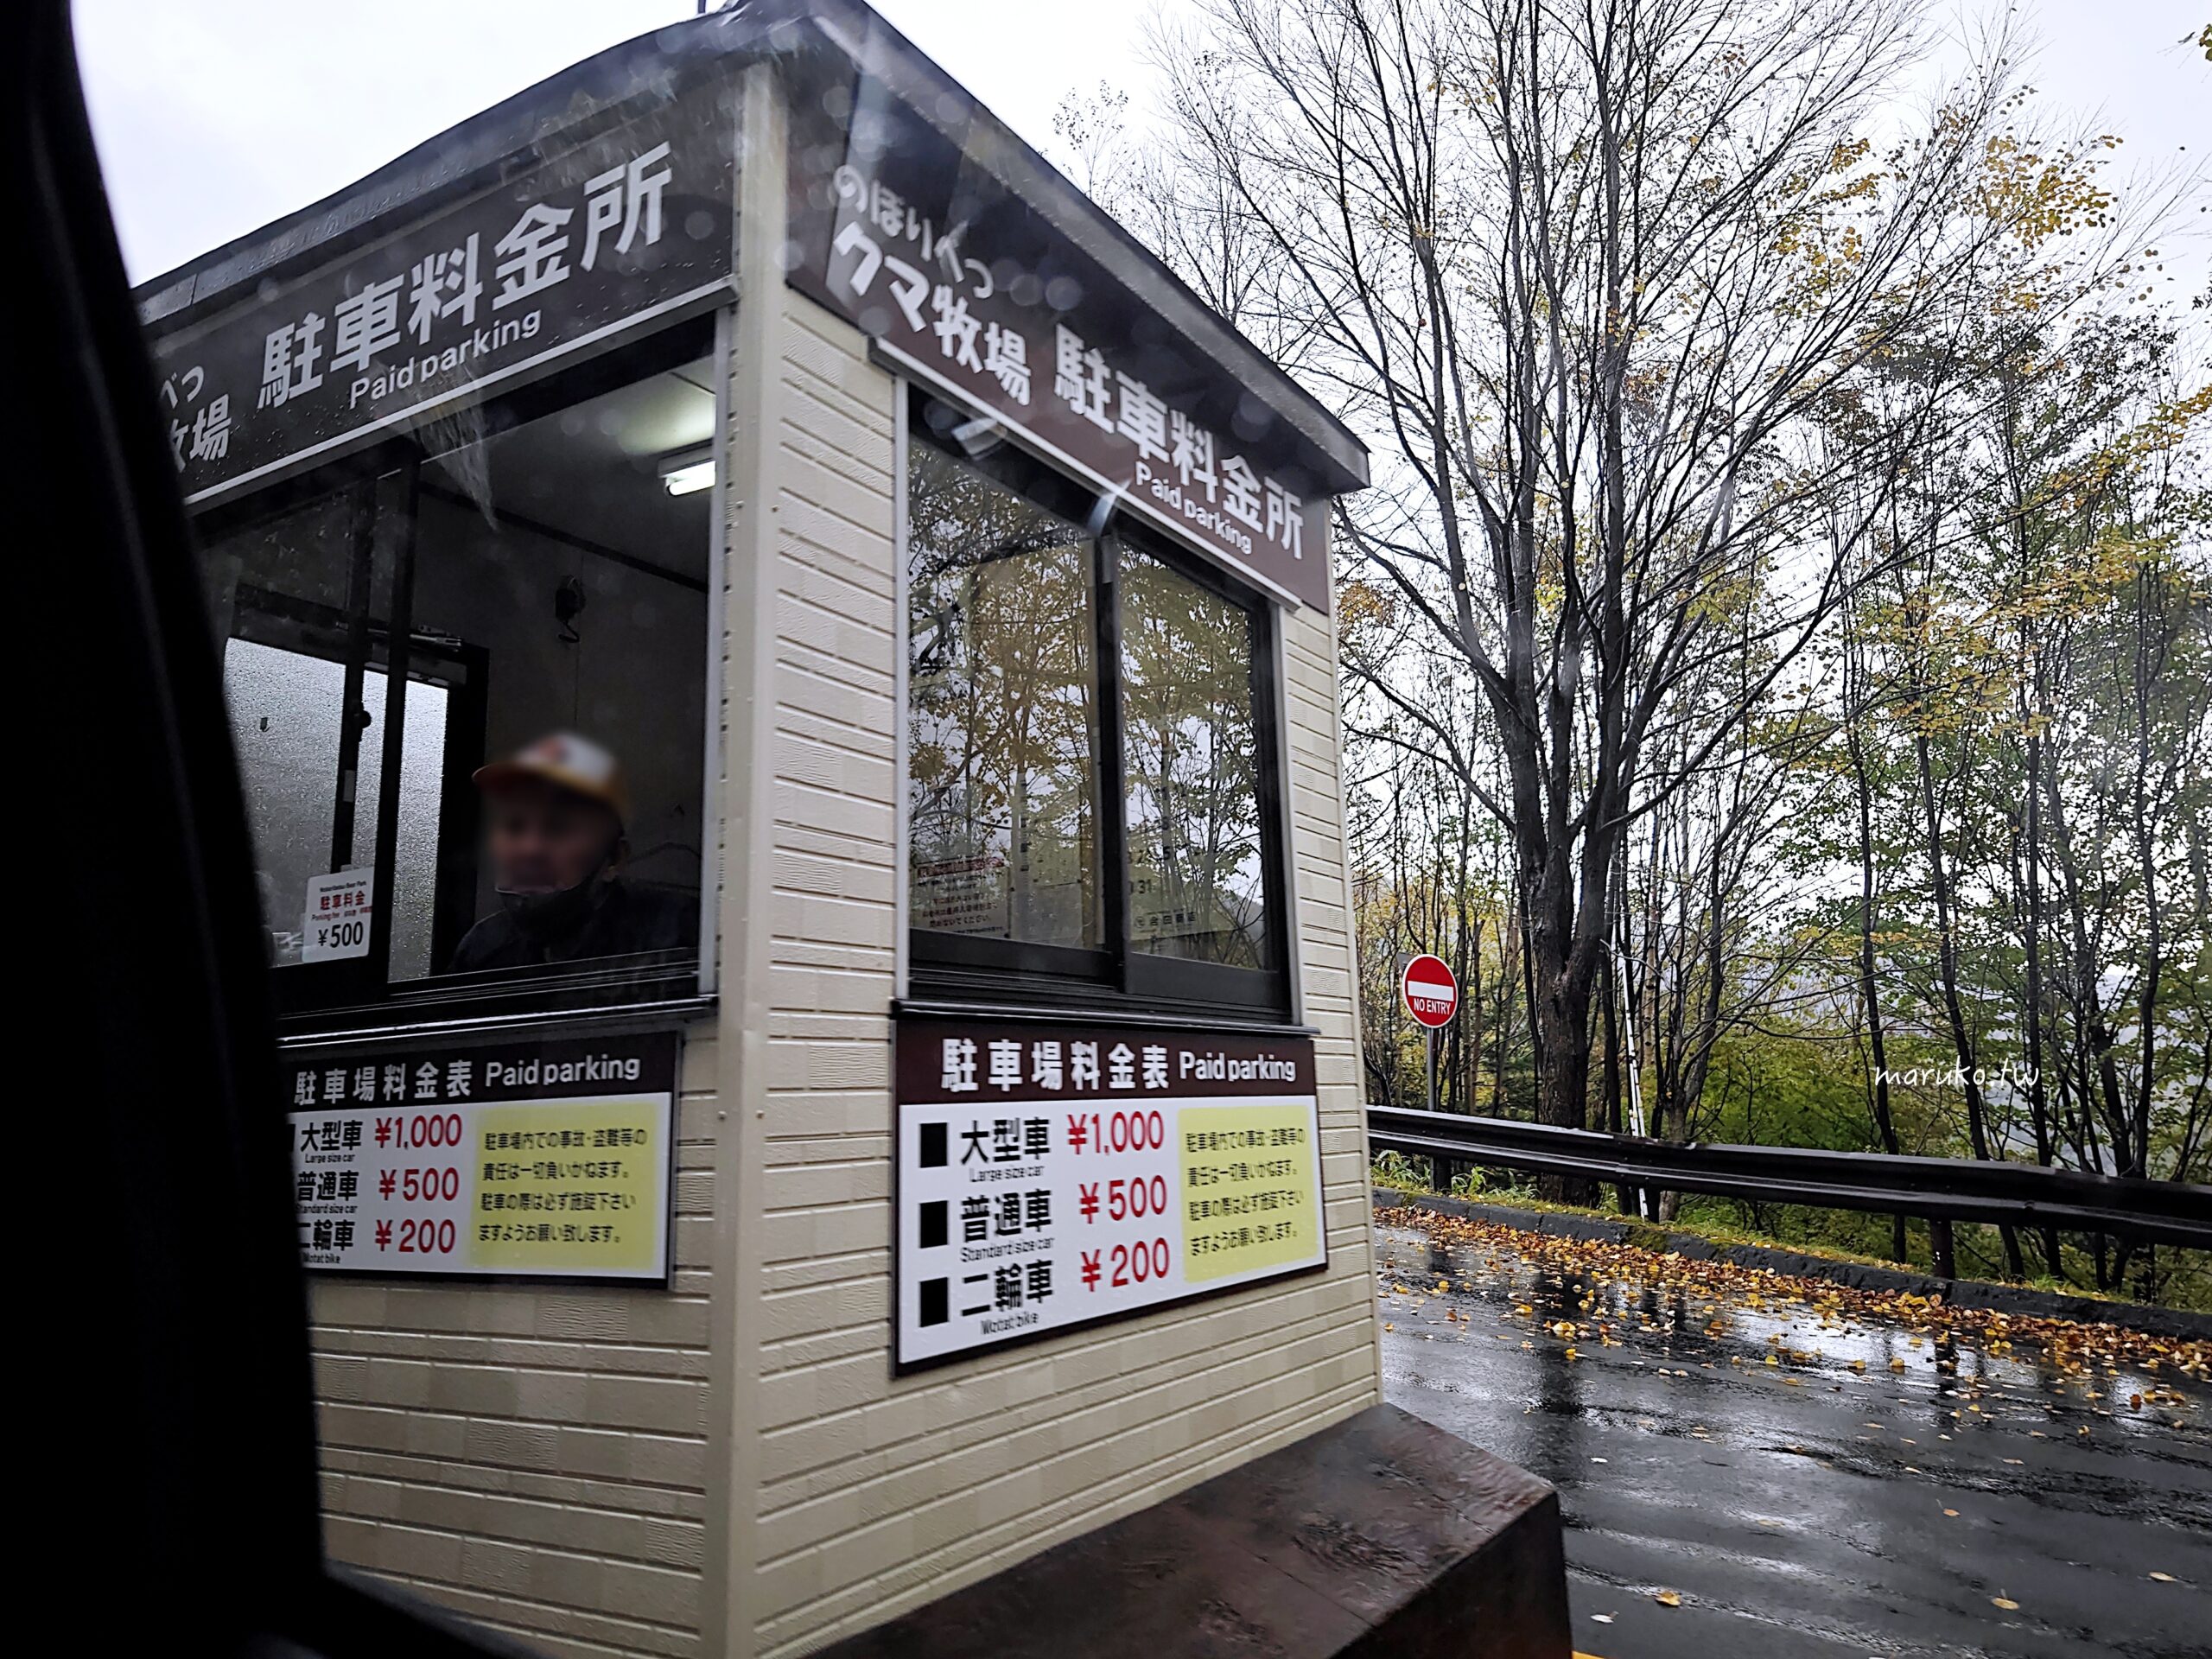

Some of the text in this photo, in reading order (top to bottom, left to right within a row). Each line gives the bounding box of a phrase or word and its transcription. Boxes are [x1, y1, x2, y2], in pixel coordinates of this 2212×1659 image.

[257, 141, 672, 410] 駐車料金所
[833, 220, 1032, 406] クマ牧場
[349, 309, 542, 410] Paid parking
[1053, 322, 1304, 559] 駐車料金所
[1135, 460, 1253, 555] Paid parking
[318, 921, 363, 948] ¥500
[1414, 998, 1451, 1015] NO ENTRY
[294, 1059, 473, 1105] 駐車場料金表
[486, 1054, 641, 1087] Paid parking
[940, 1038, 1170, 1093] 駐車場料金表
[1179, 1051, 1297, 1082] Paid parking
[300, 1120, 363, 1152] 大型車
[960, 1110, 1165, 1165] 大型車 ¥1,000
[297, 1167, 460, 1202] 普通車 ¥500
[969, 1166, 1044, 1183] Large size car
[961, 1175, 1167, 1243] 普通車 ¥500
[375, 1219, 455, 1253] ¥200
[960, 1238, 1055, 1262] Standard size car
[961, 1237, 1170, 1316] 二輪車 ¥200
